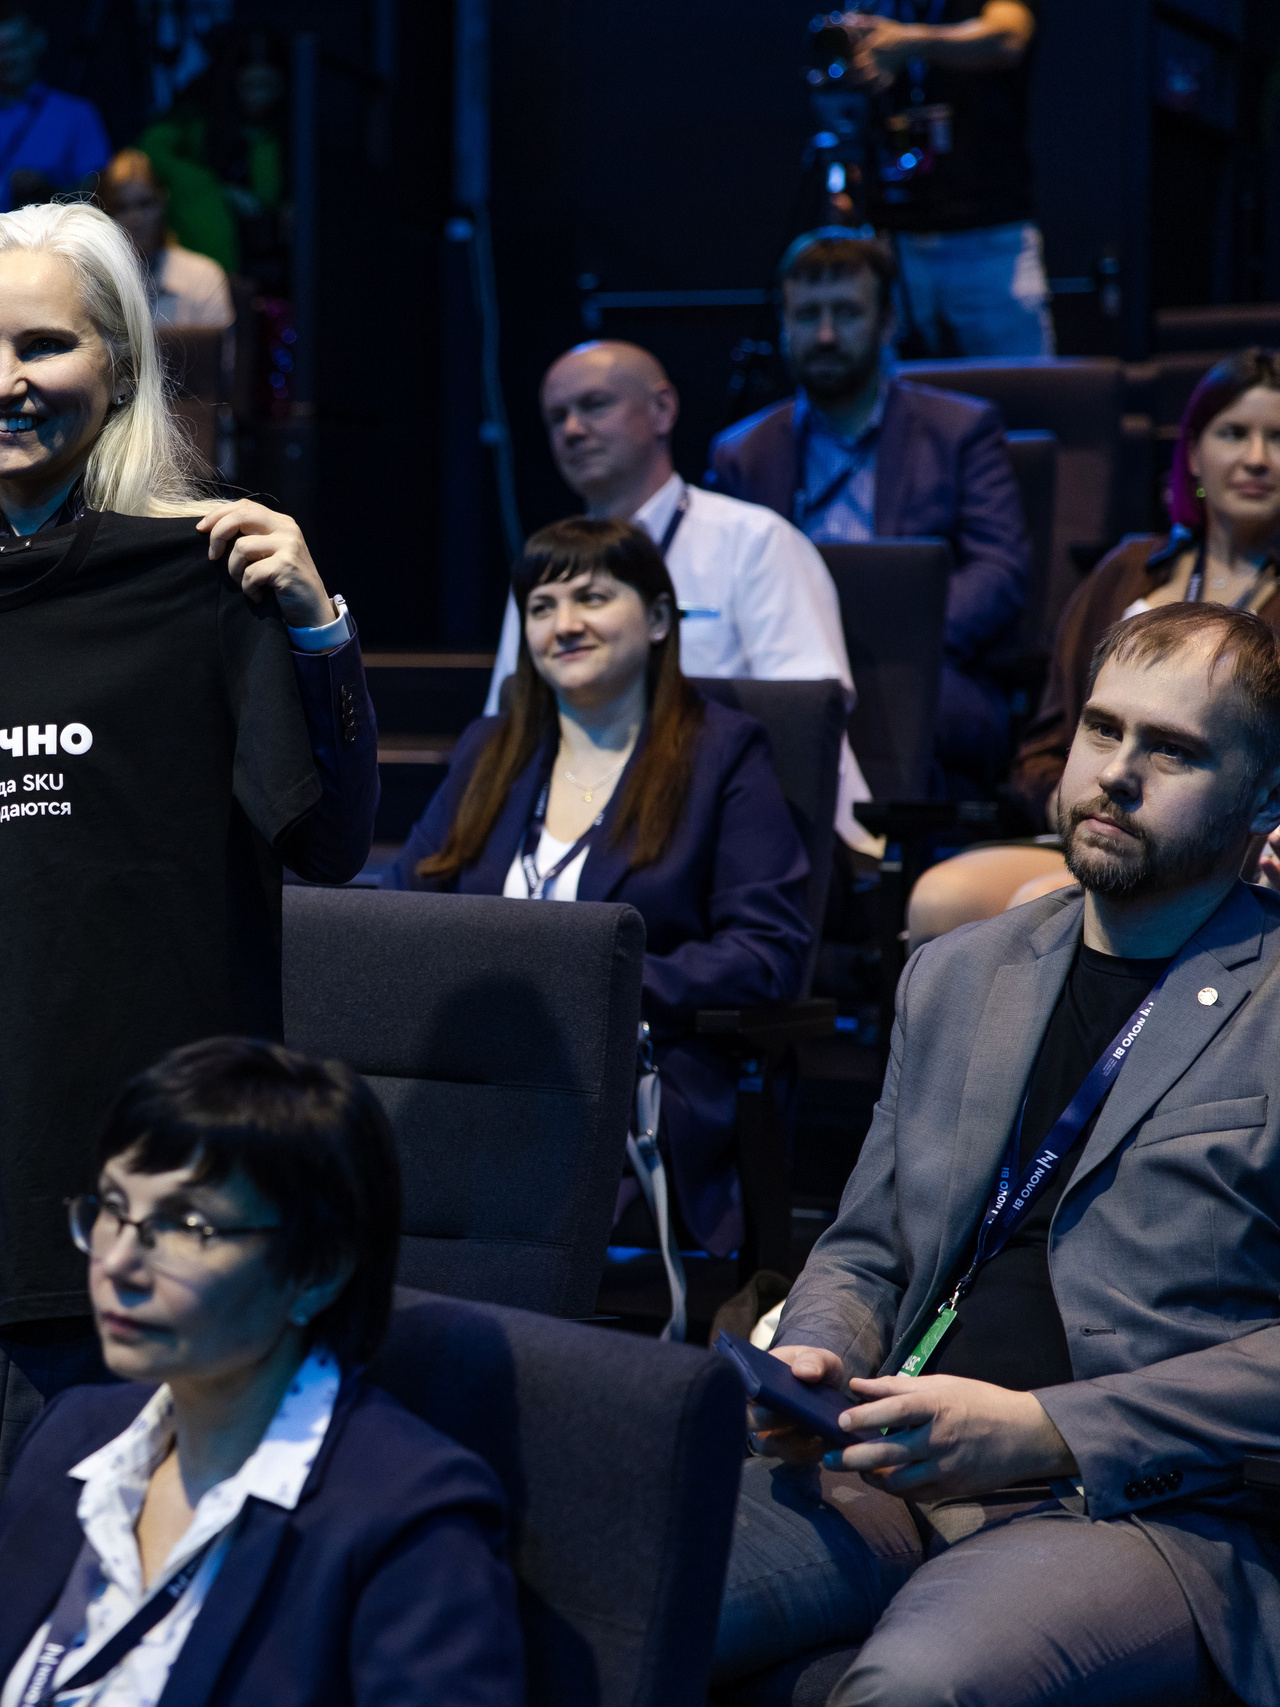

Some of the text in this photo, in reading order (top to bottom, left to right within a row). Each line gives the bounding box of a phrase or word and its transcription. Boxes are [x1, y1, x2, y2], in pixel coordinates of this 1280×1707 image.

[22, 773, 64, 792] SKU
[1112, 1017, 1146, 1060] NOVO BI
[1000, 1166, 1010, 1179] BI
[1012, 1166, 1046, 1211] NOVO BI
